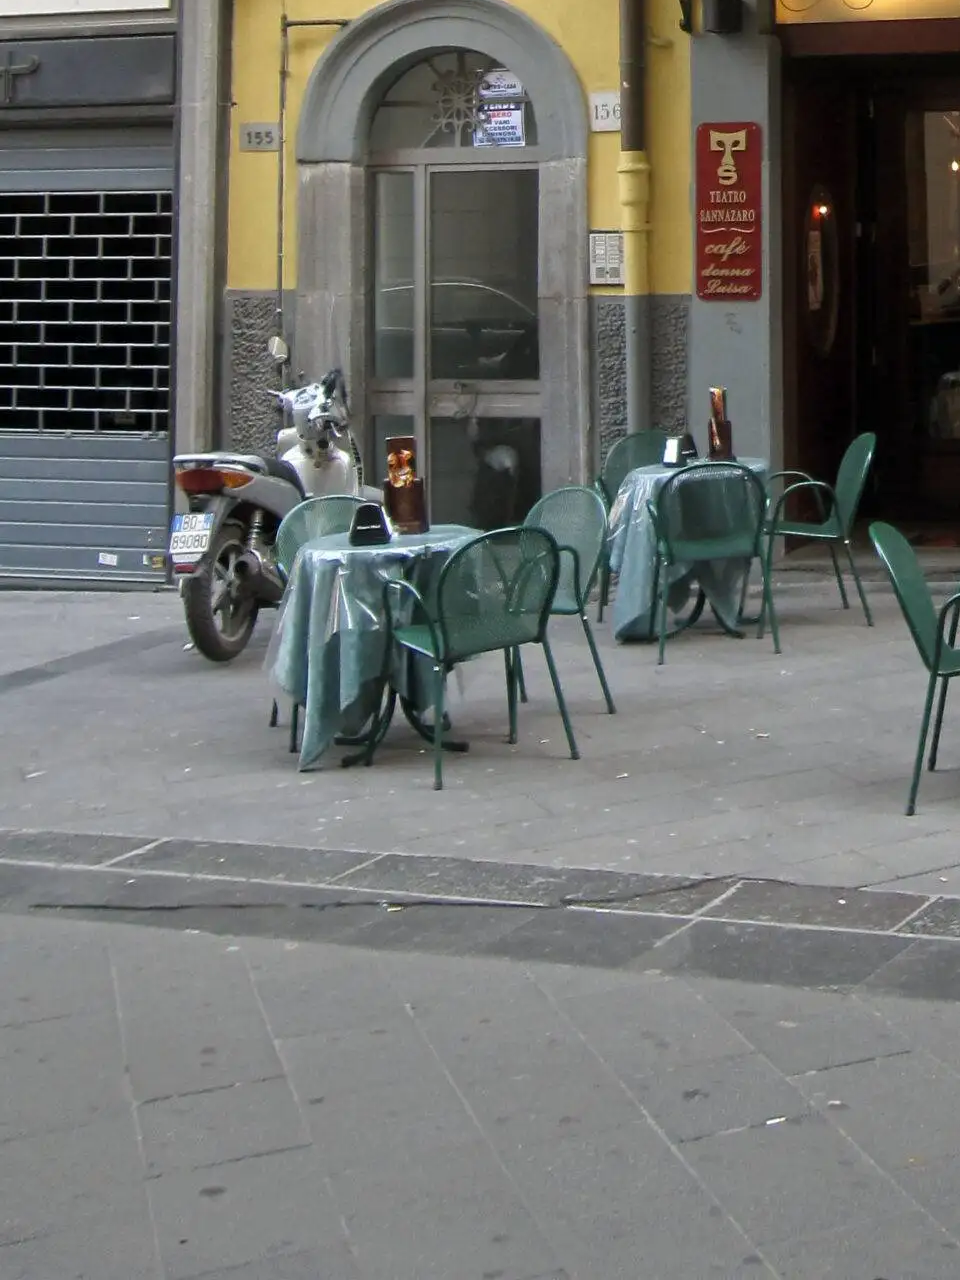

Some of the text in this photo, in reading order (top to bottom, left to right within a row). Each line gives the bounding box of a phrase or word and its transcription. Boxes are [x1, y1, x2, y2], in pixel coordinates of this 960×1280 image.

[247, 131, 274, 146] 155
[710, 190, 747, 203] TEATRO
[700, 209, 755, 223] SANNAZARO
[702, 263, 753, 277] donna
[704, 278, 753, 295] Luisa
